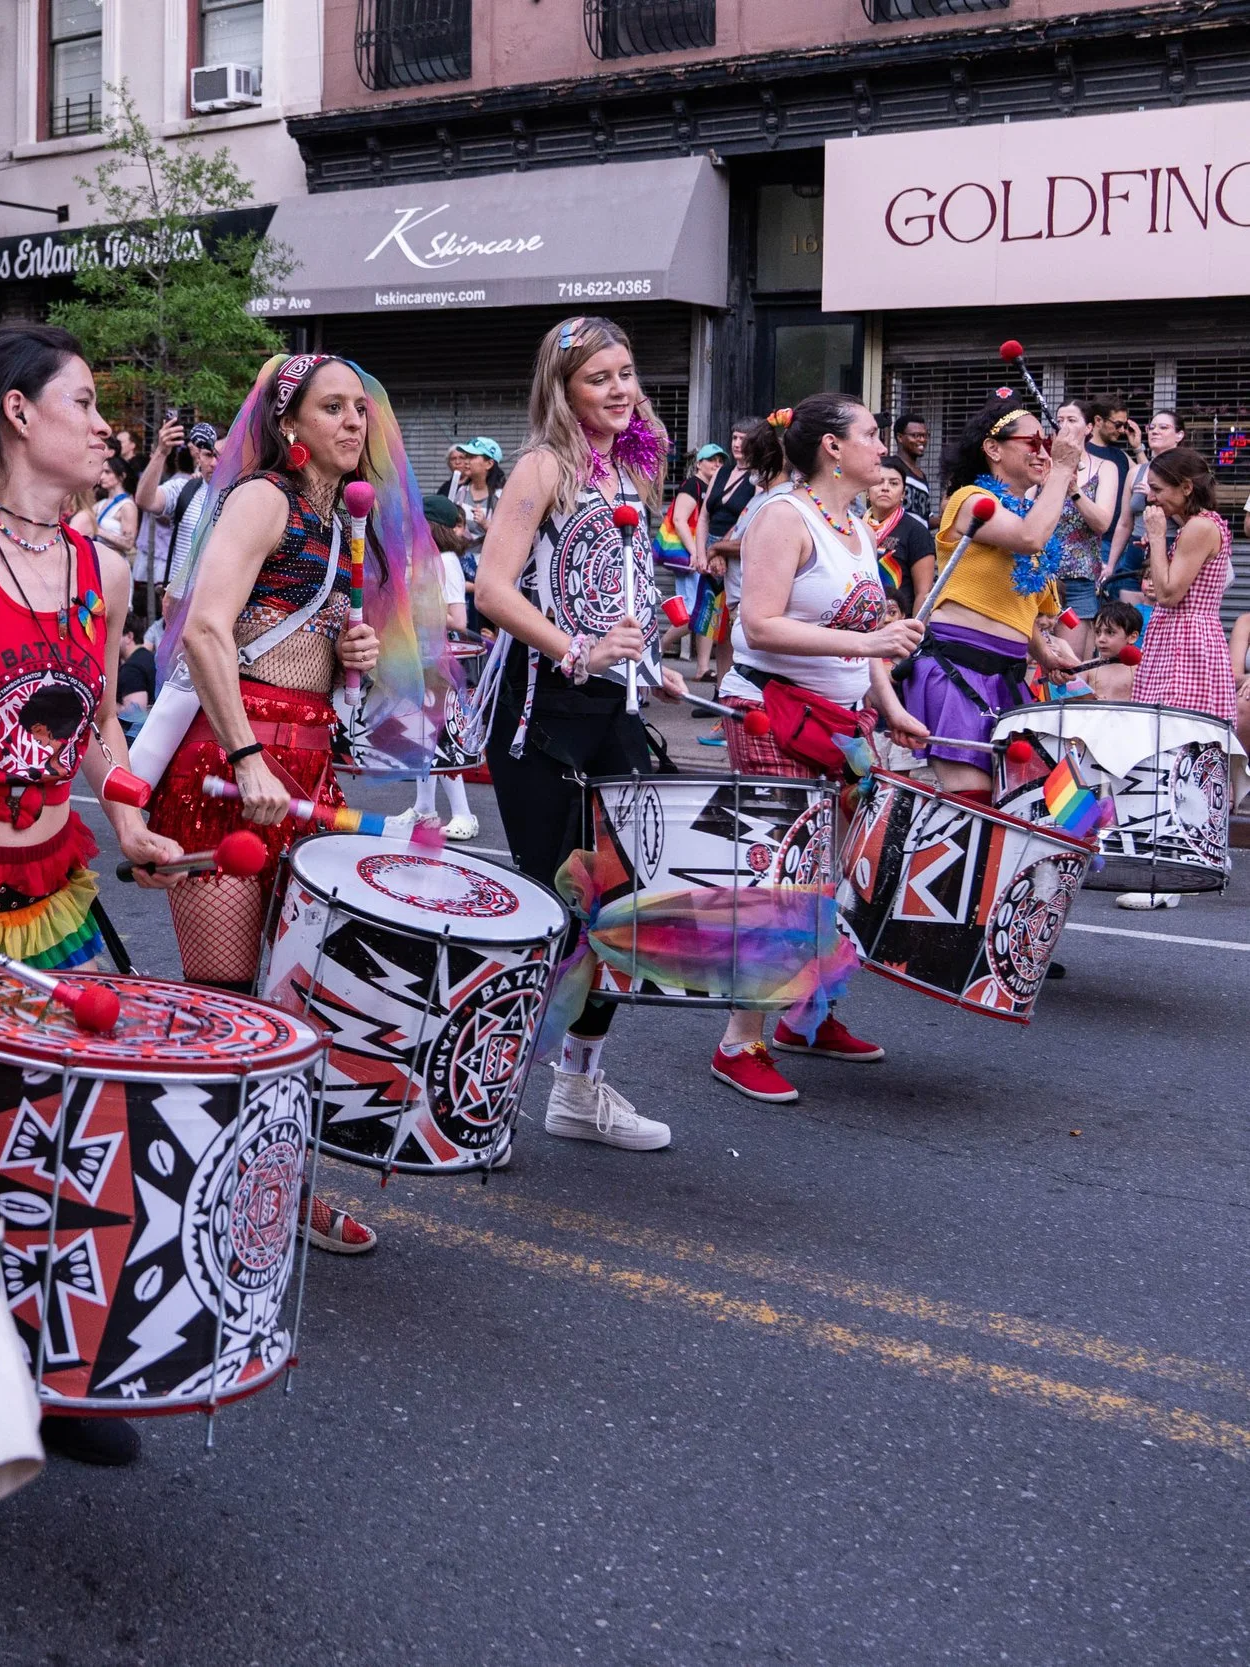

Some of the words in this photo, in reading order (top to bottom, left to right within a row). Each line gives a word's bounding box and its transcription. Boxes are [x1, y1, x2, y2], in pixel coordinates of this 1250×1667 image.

[364, 203, 460, 268] K
[424, 231, 545, 259] Skincare
[14, 234, 99, 279] Enfants
[375, 289, 486, 306] kskincarenyc.com
[558, 279, 651, 297] 718-622-0365
[250, 298, 270, 312] 169
[288, 296, 311, 310] Ave
[237, 1252, 284, 1287] MUNDO
